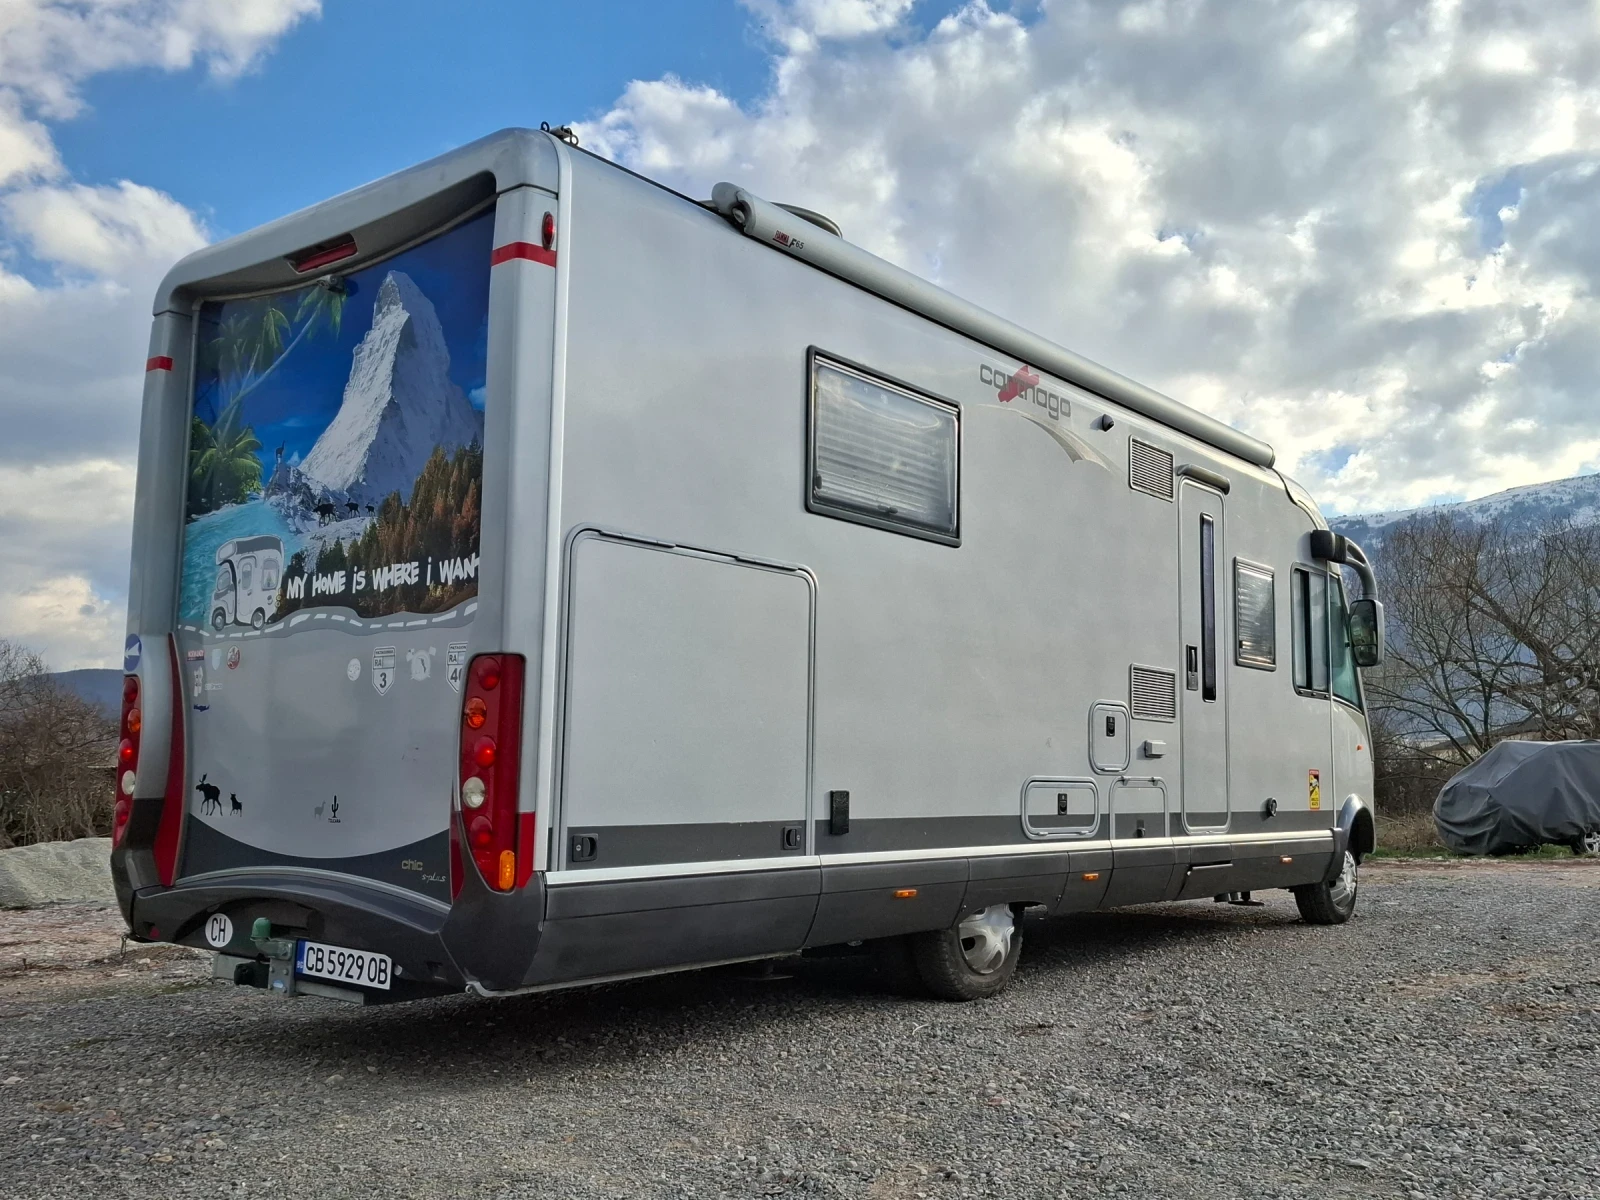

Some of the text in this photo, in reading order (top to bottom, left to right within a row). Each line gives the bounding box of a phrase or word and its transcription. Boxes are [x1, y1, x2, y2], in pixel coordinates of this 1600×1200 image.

[788, 238, 805, 250] F65
[286, 573, 307, 599] MY
[312, 570, 346, 597] HOME
[372, 561, 419, 592] WHERE
[379, 672, 387, 689] 3
[401, 859, 424, 871] chic
[211, 917, 226, 943] CH
[306, 946, 325, 973] CB
[327, 950, 365, 980] 5929
